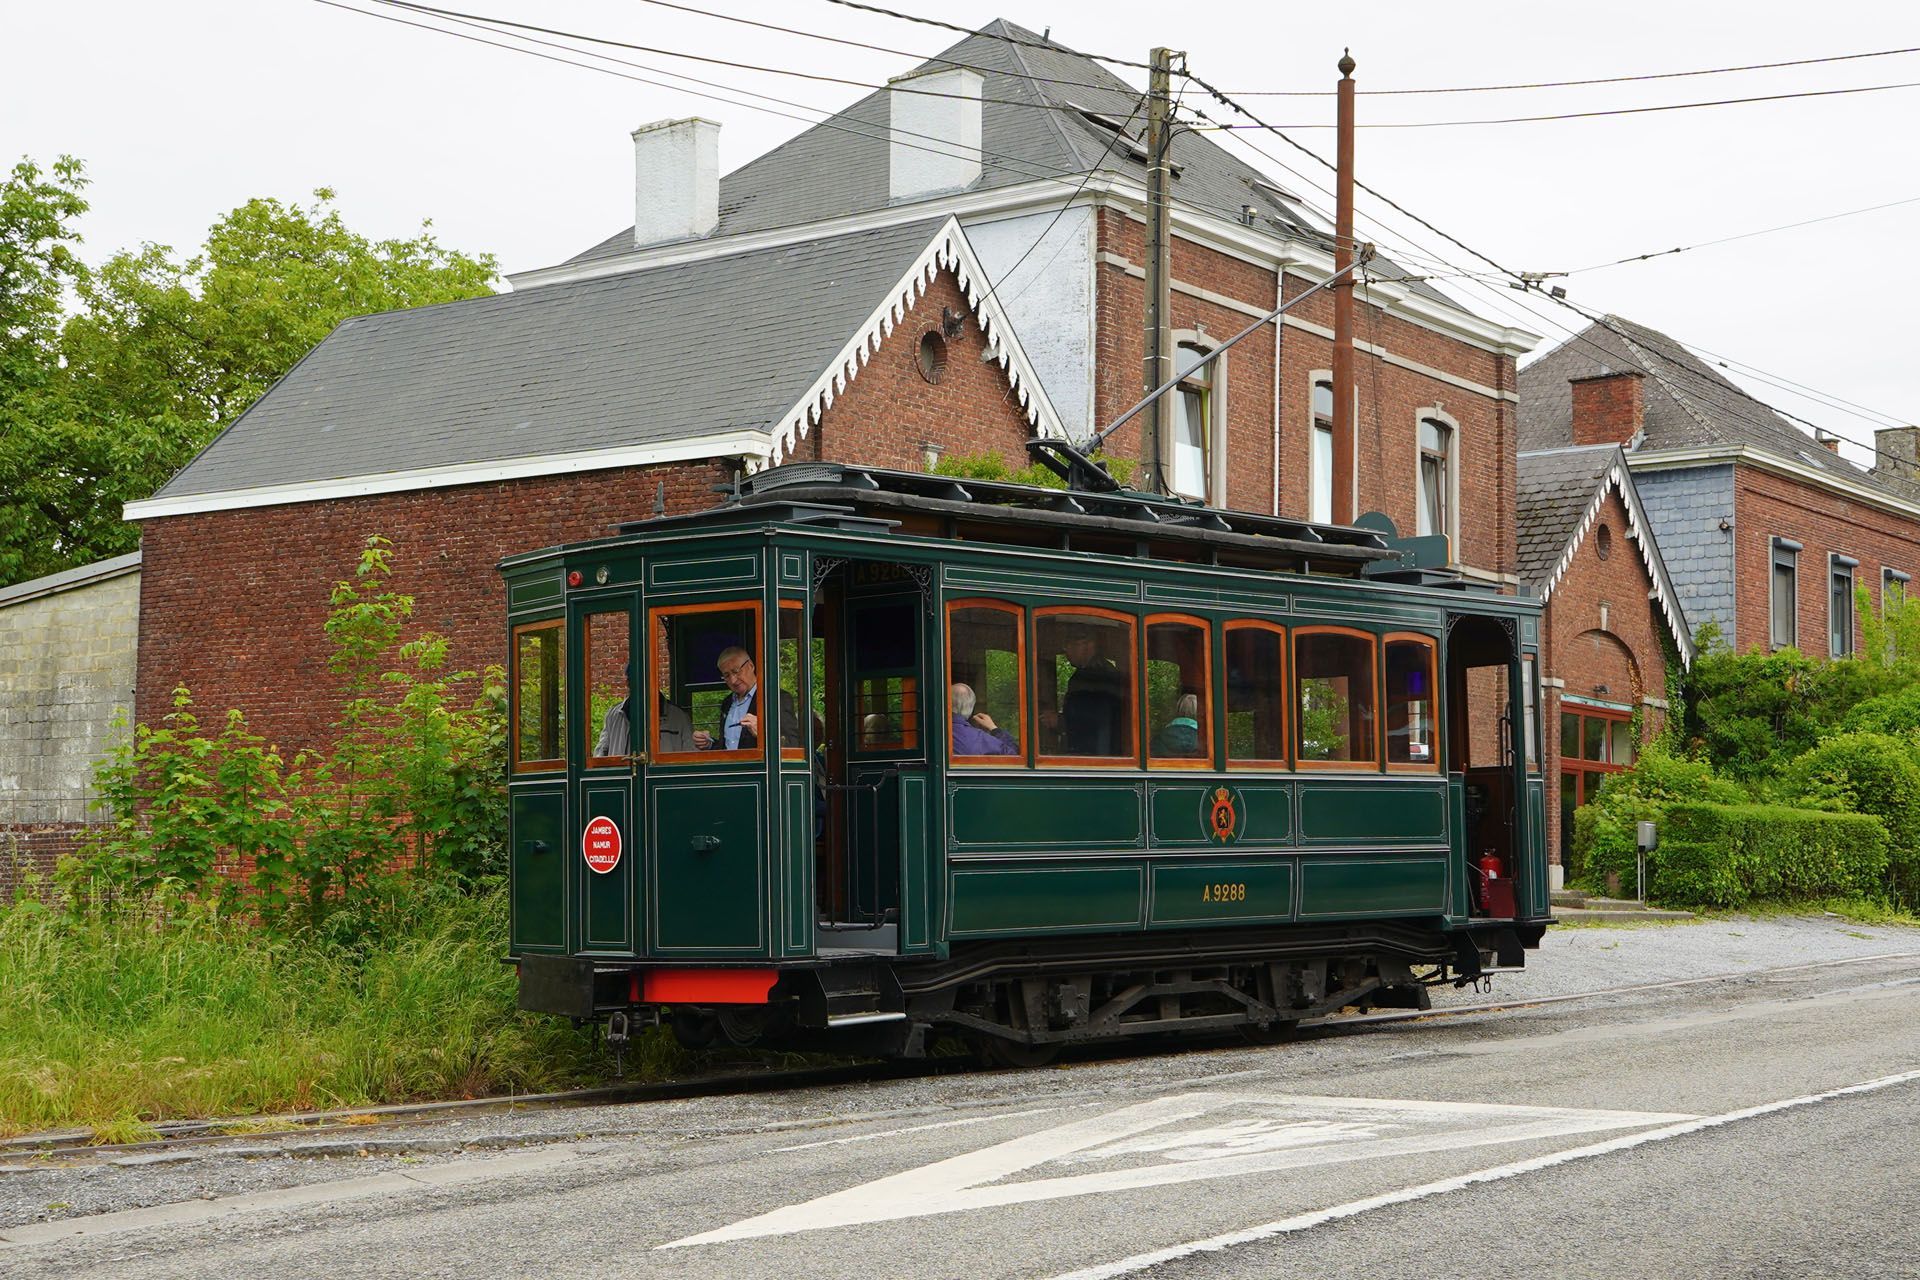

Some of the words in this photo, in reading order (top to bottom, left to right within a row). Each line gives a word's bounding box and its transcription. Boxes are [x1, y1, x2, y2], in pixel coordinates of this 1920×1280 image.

[591, 826, 612, 835] JAMBES
[592, 841, 611, 849] NAMUR
[589, 855, 615, 864] CITADELLE
[1202, 883, 1246, 902] A.9288
